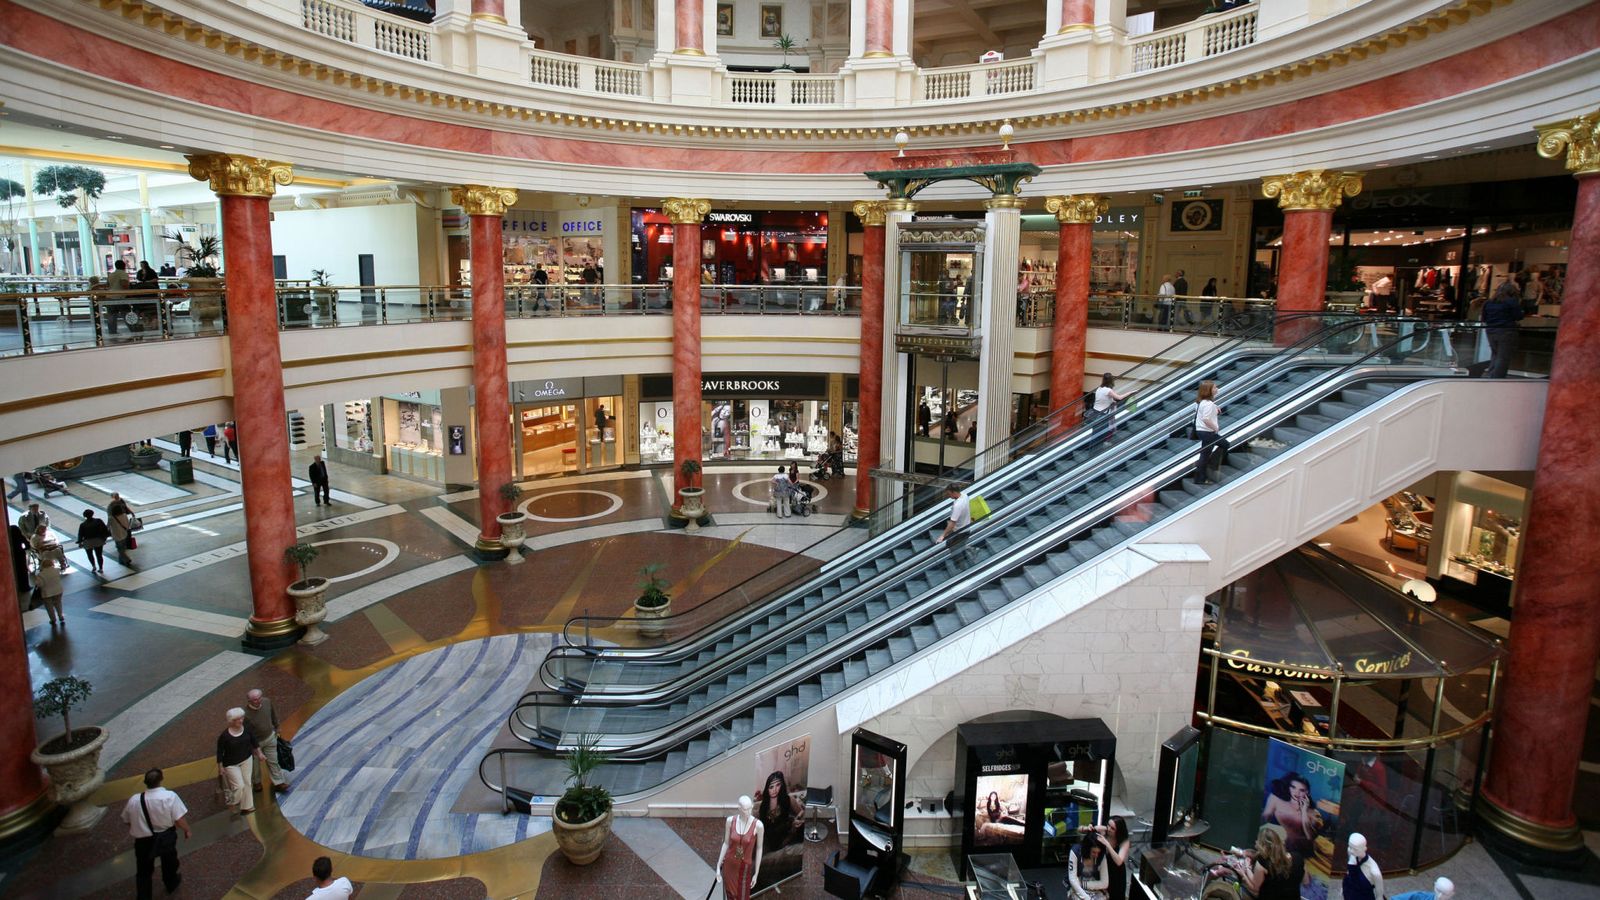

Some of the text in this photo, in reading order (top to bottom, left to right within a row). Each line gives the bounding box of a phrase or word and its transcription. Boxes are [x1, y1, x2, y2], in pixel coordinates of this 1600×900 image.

[709, 213, 752, 222] SWAROVSKI
[562, 221, 602, 232] OFFICE
[534, 388, 565, 397] OMEGA
[1227, 649, 1412, 680] Custome Services
[784, 741, 806, 761] ghd
[1068, 744, 1092, 759] ghd
[1306, 760, 1338, 777] ghd
